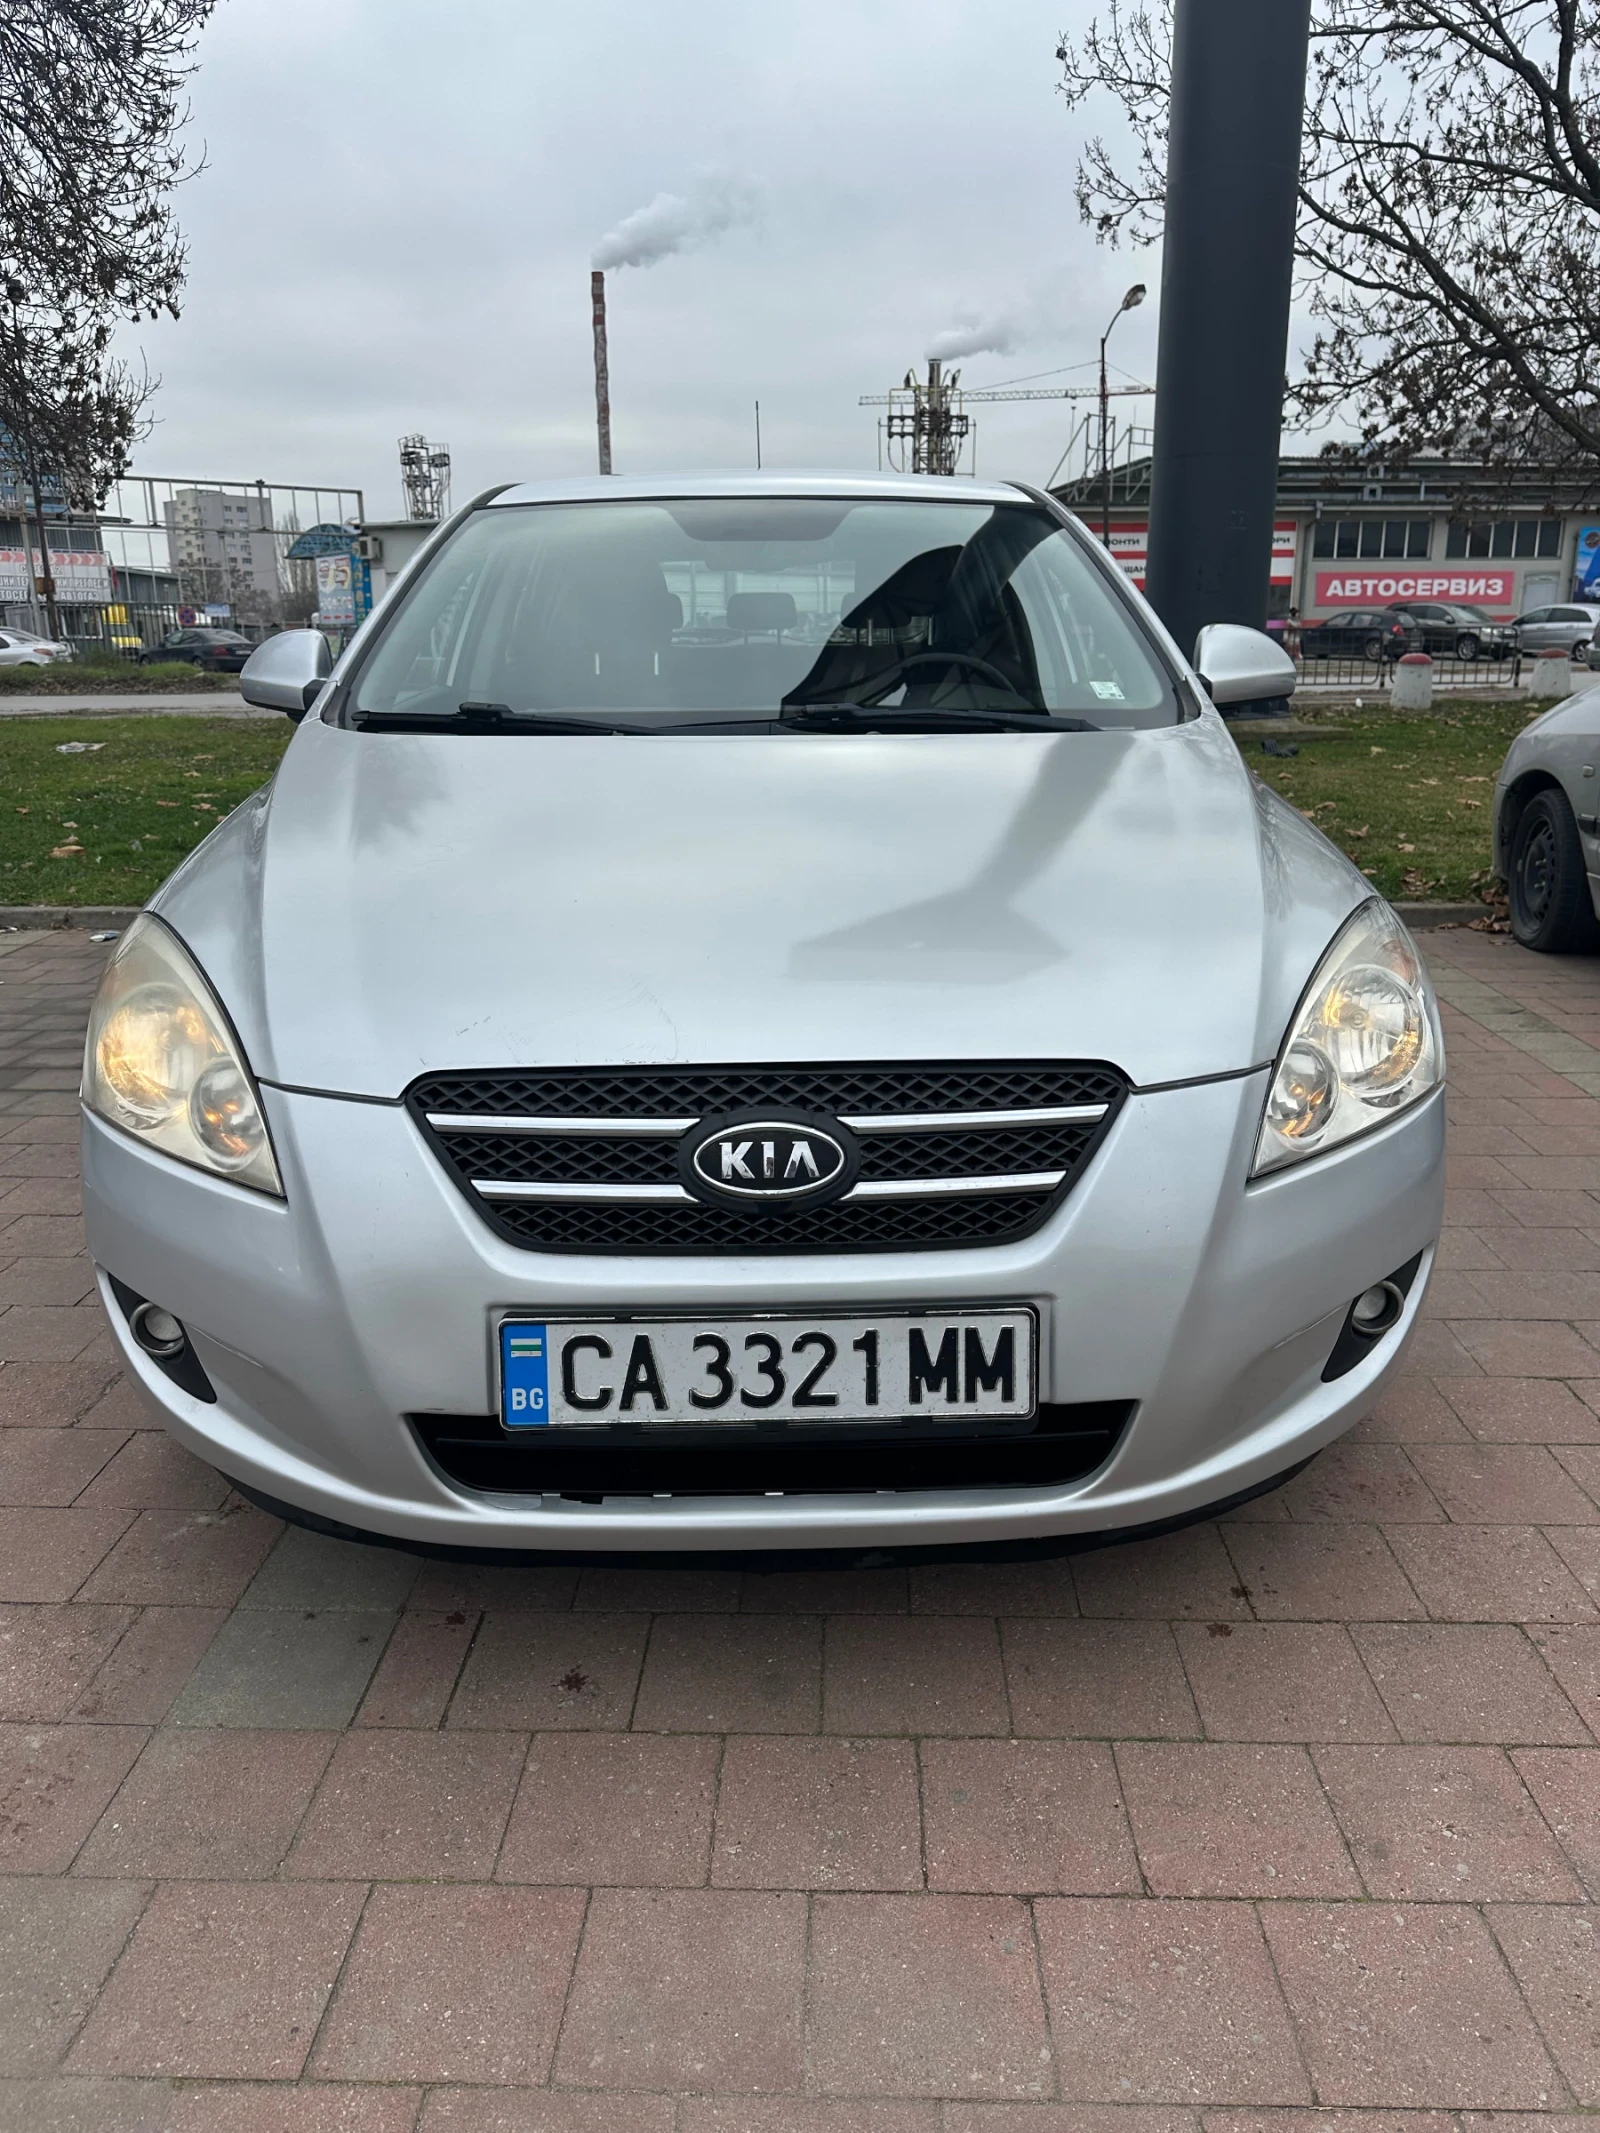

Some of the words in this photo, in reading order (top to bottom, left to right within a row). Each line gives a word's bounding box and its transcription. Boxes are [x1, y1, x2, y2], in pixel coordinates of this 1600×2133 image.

[1325, 578, 1503, 597] АВТОСЕРВИЗ
[719, 1140, 820, 1179] KIA
[688, 1328, 879, 1410] 3321
[908, 1324, 1016, 1404] MM
[511, 1387, 544, 1411] BG
